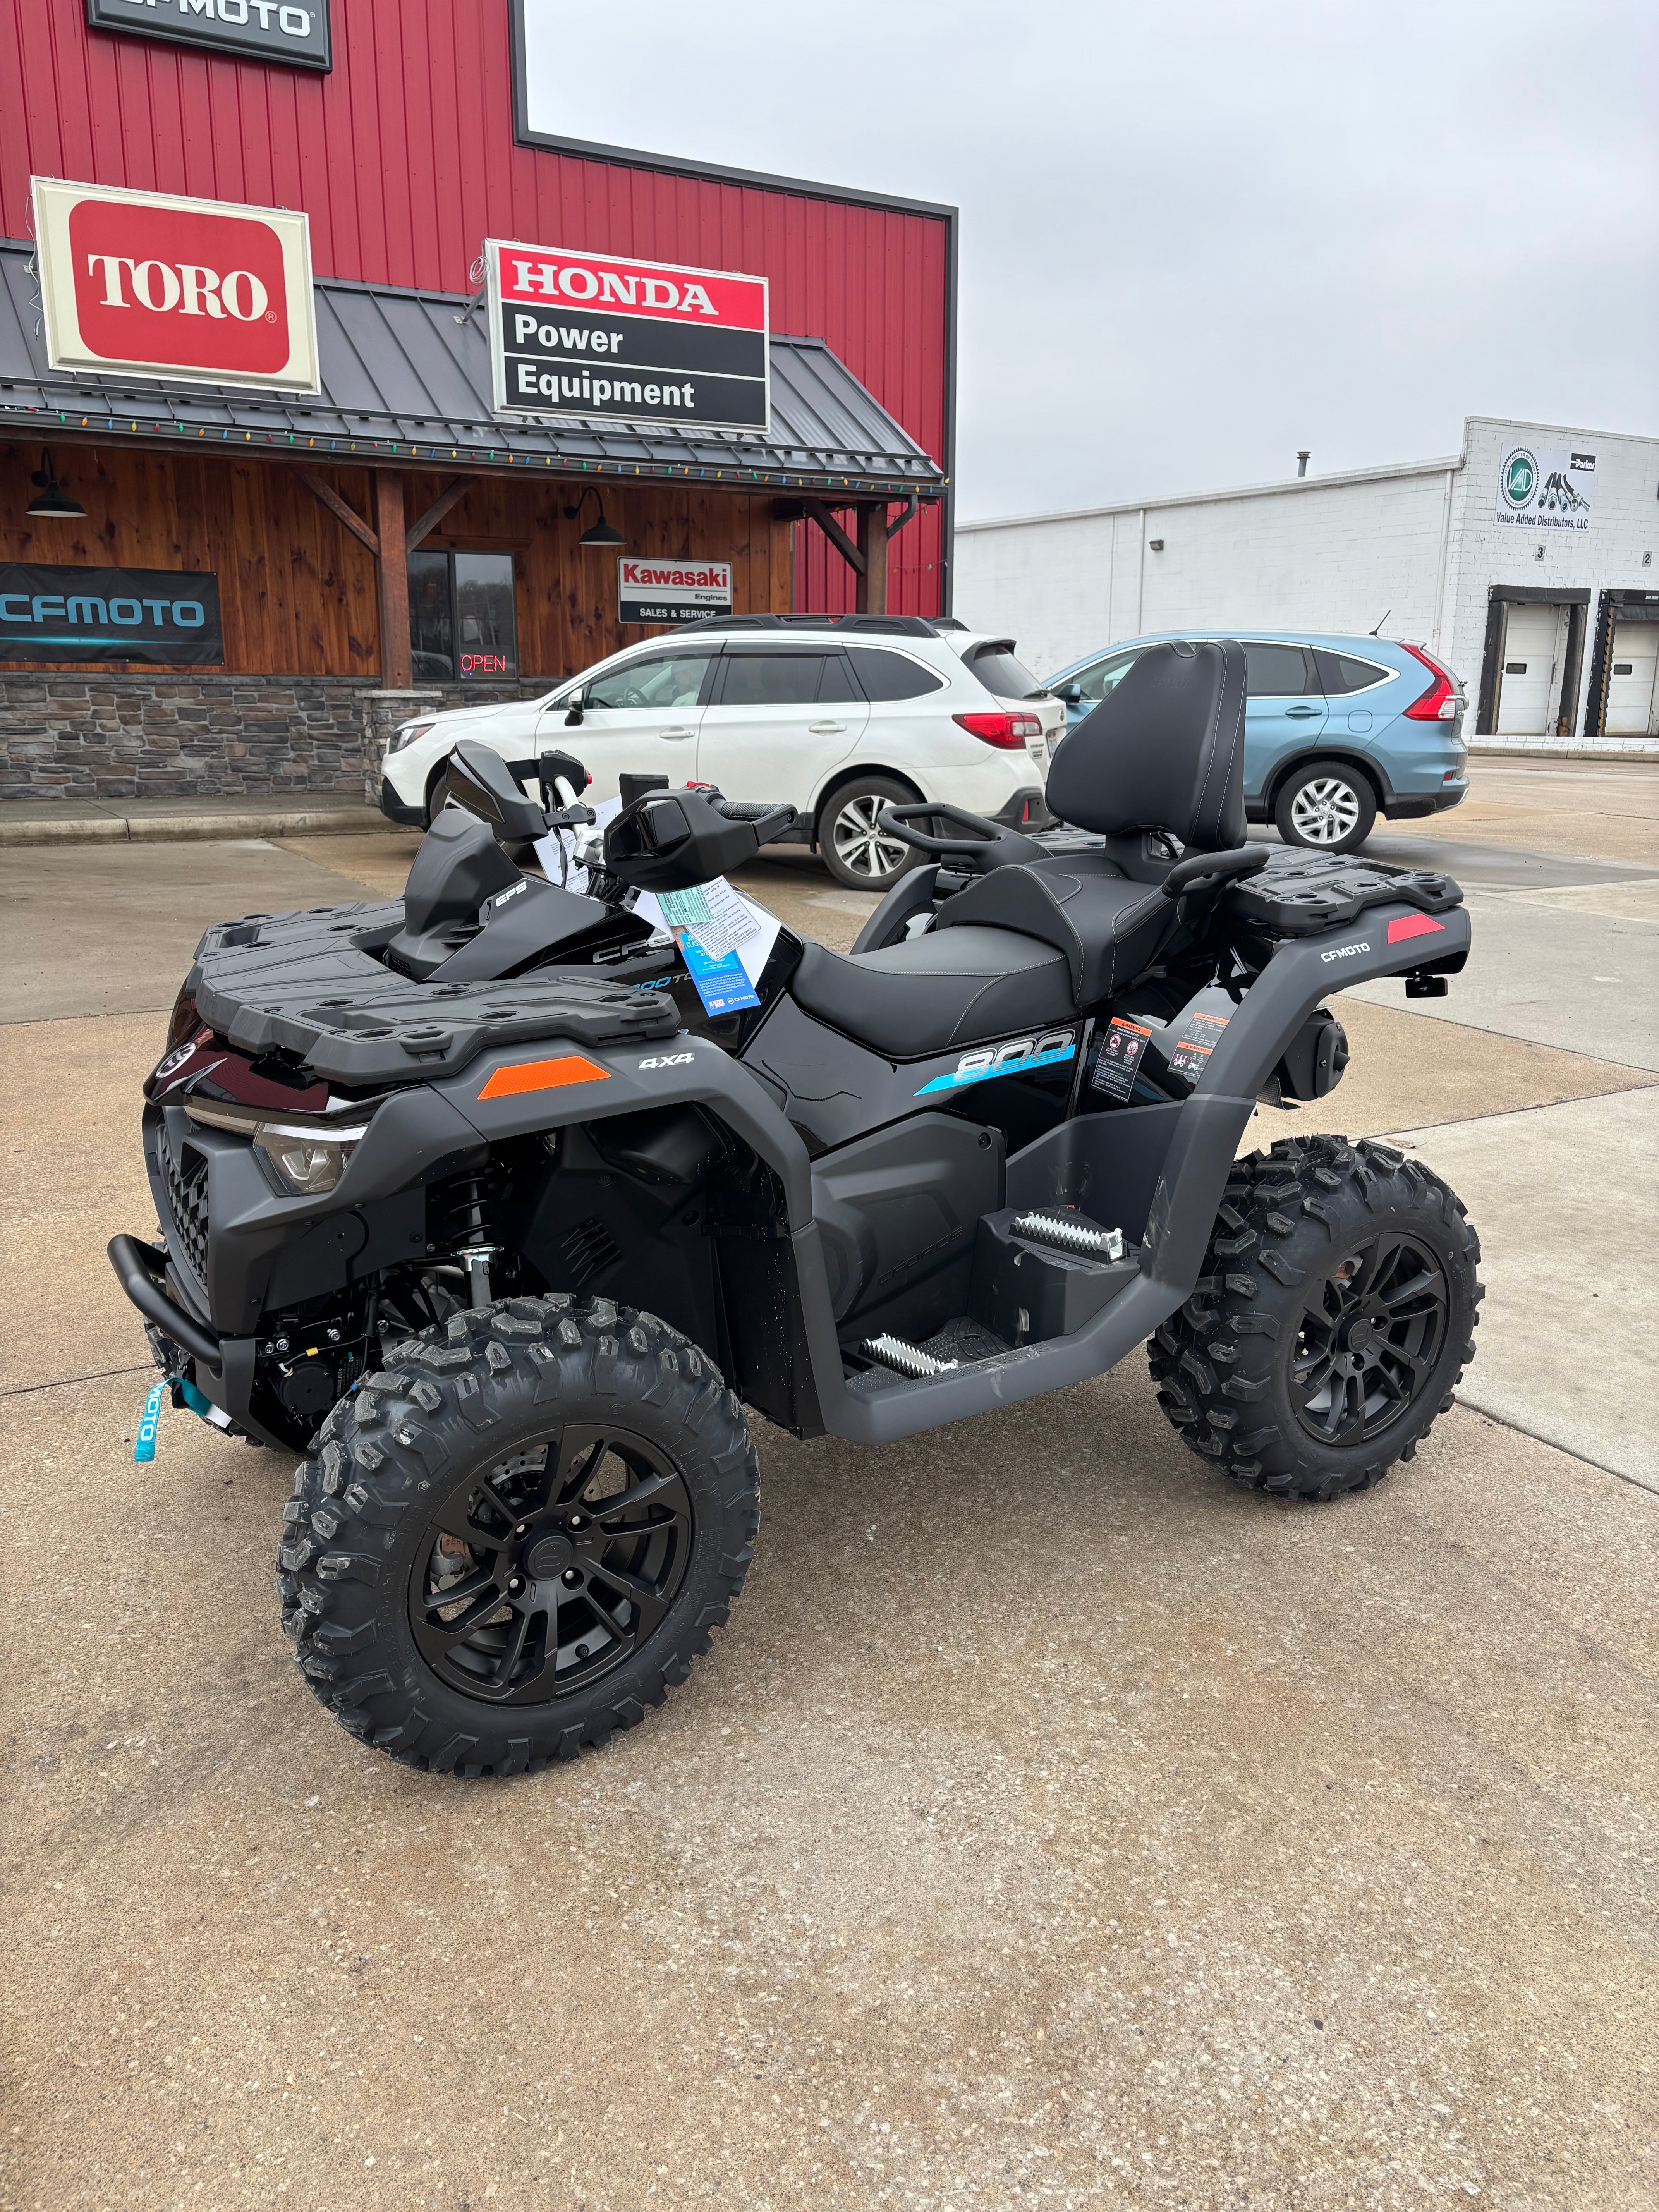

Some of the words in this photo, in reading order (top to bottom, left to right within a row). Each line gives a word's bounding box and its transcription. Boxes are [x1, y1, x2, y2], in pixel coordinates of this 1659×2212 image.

[88, 254, 268, 321] TORO
[512, 260, 719, 316] HONDA
[515, 314, 623, 354] Power
[517, 364, 695, 408] Equipment
[1511, 452, 1525, 462] MATTER
[1575, 458, 1595, 470] Parker
[1497, 512, 1514, 523] Value
[1516, 513, 1536, 525] Added
[1537, 515, 1575, 530] Distributors,
[1577, 518, 1588, 529] LLC
[1537, 547, 1544, 558] 3
[1644, 553, 1650, 564] 2
[623, 563, 727, 587] Kawasaki
[694, 593, 728, 602] Engines
[0, 593, 204, 627] CFMOTO
[639, 607, 668, 618] SALES
[670, 609, 677, 618] &
[680, 609, 716, 619] SERVICE
[461, 654, 505, 672] OPEN
[495, 881, 527, 907] EPS
[1320, 943, 1371, 963] CFMOTO
[1125, 1022, 1141, 1032] WARNING
[638, 1052, 695, 1071] 4X4
[957, 1029, 1076, 1082] 800
